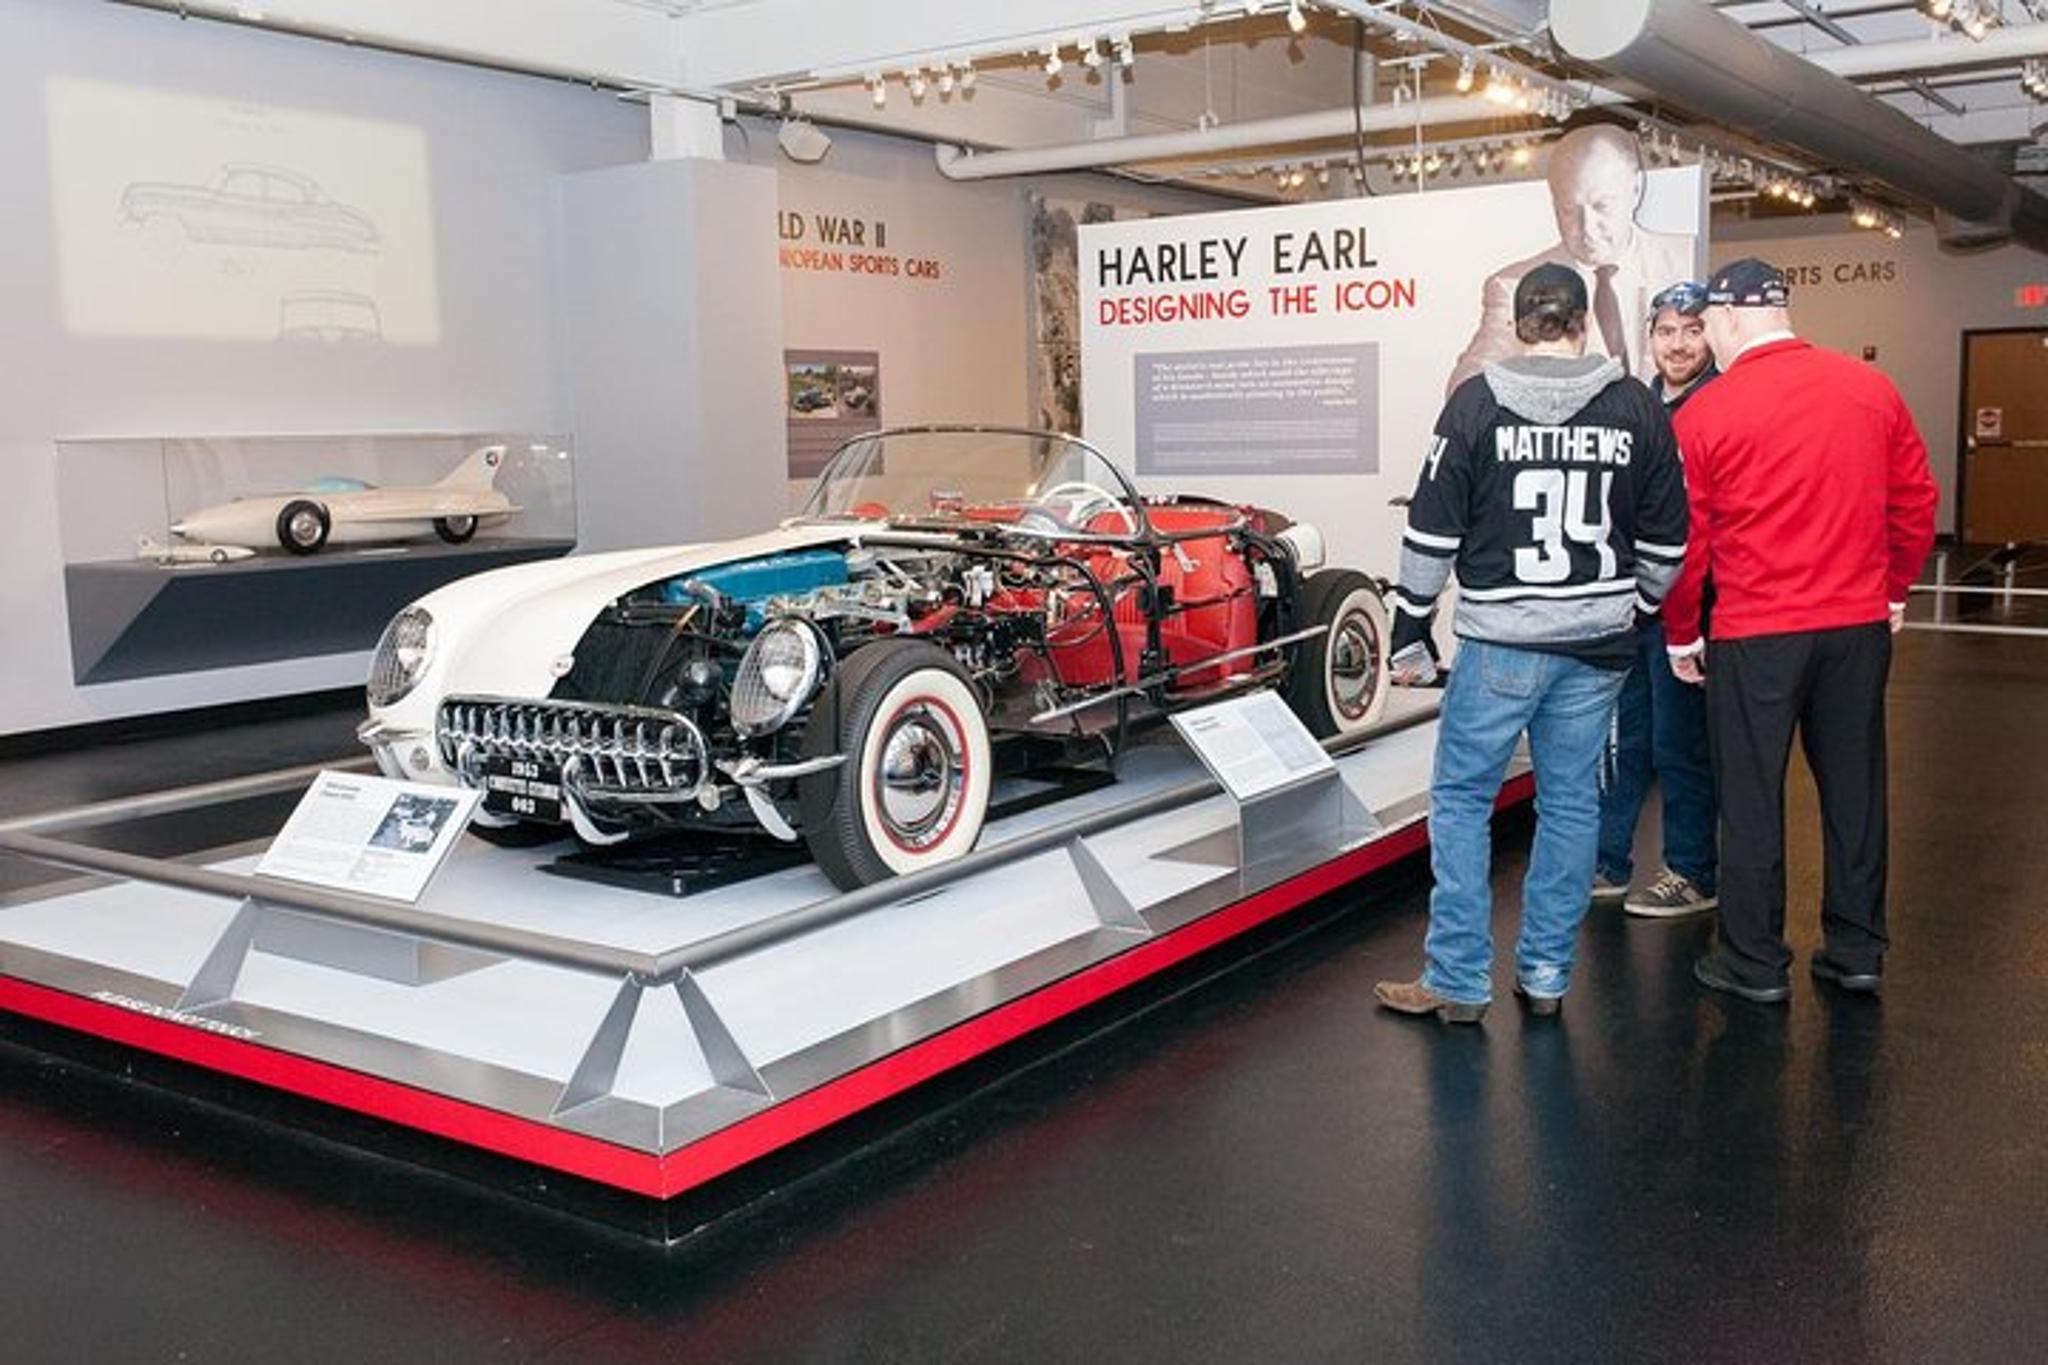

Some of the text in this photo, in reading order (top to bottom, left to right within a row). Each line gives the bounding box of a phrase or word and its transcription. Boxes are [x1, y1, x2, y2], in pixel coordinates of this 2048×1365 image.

[816, 215, 865, 246] WAR
[850, 253, 899, 276] SPORTS
[904, 258, 940, 279] CARS
[1099, 227, 1378, 287] HARLEY EARL
[1834, 261, 1896, 282] CARS
[1099, 278, 1416, 326] DESIGNING THE ICON
[1495, 426, 1633, 465] MATTHEWS
[1513, 469, 1617, 583] 34
